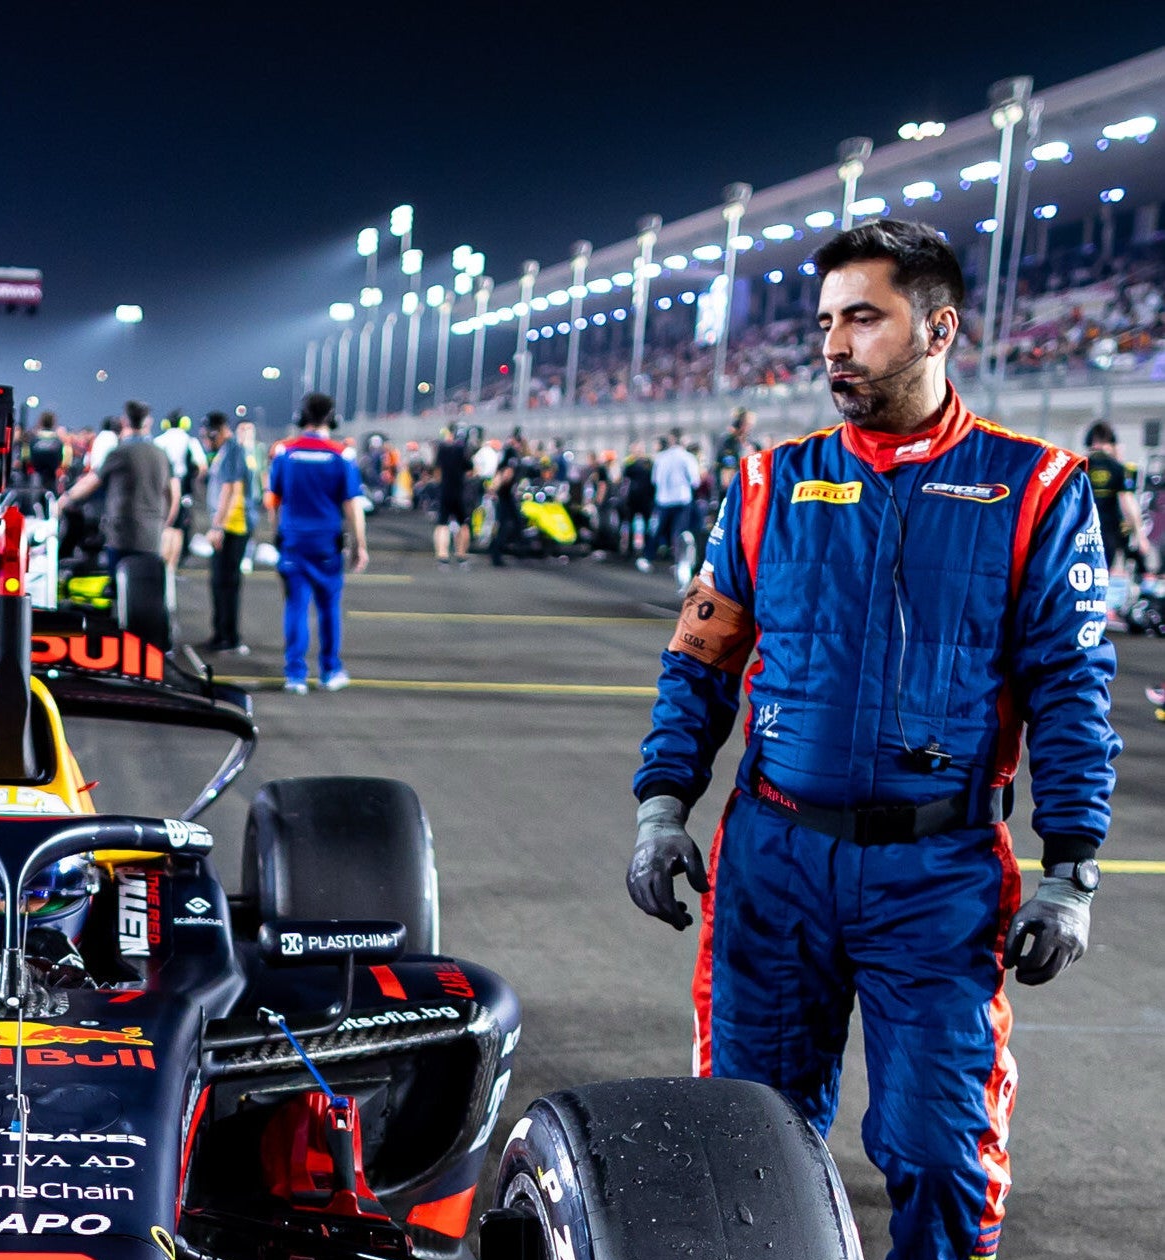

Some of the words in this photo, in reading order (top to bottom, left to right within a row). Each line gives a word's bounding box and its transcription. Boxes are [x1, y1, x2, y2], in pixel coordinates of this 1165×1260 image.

[798, 485, 855, 500] PIRELLI
[147, 907, 160, 944] RED
[173, 916, 224, 926] scalefocus
[308, 933, 400, 950] PLASTCHIM-T
[337, 1006, 460, 1031] itsofia.bg
[25, 1048, 156, 1070] Bull
[79, 1153, 136, 1169] AD
